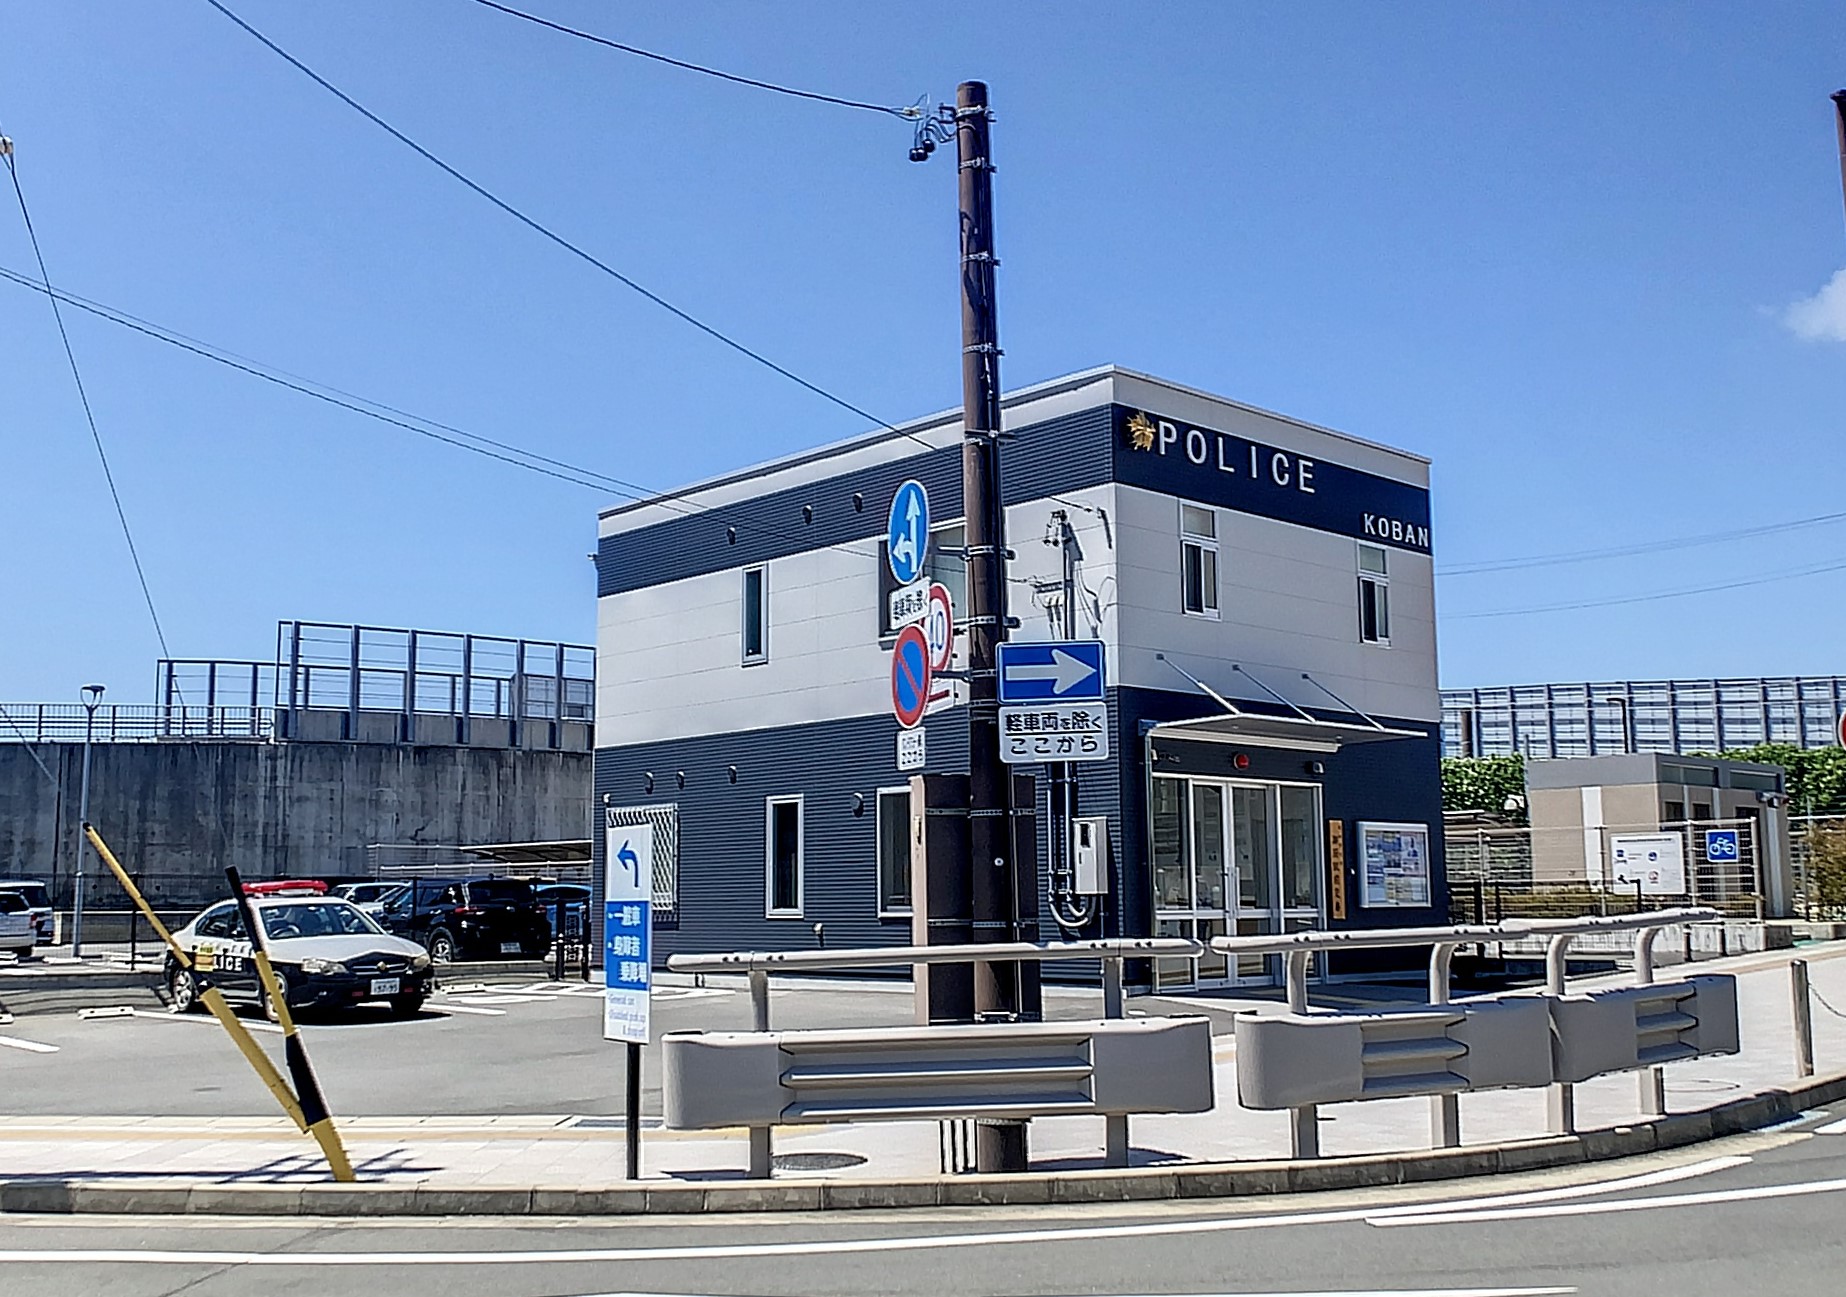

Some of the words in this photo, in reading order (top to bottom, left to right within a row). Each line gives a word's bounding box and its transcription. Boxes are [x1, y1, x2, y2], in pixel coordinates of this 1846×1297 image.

[1158, 419, 1316, 494] POLICE
[1363, 512, 1429, 548] KOBAN
[1005, 711, 1102, 732] 軽車両を除く
[1011, 735, 1098, 754] ここから
